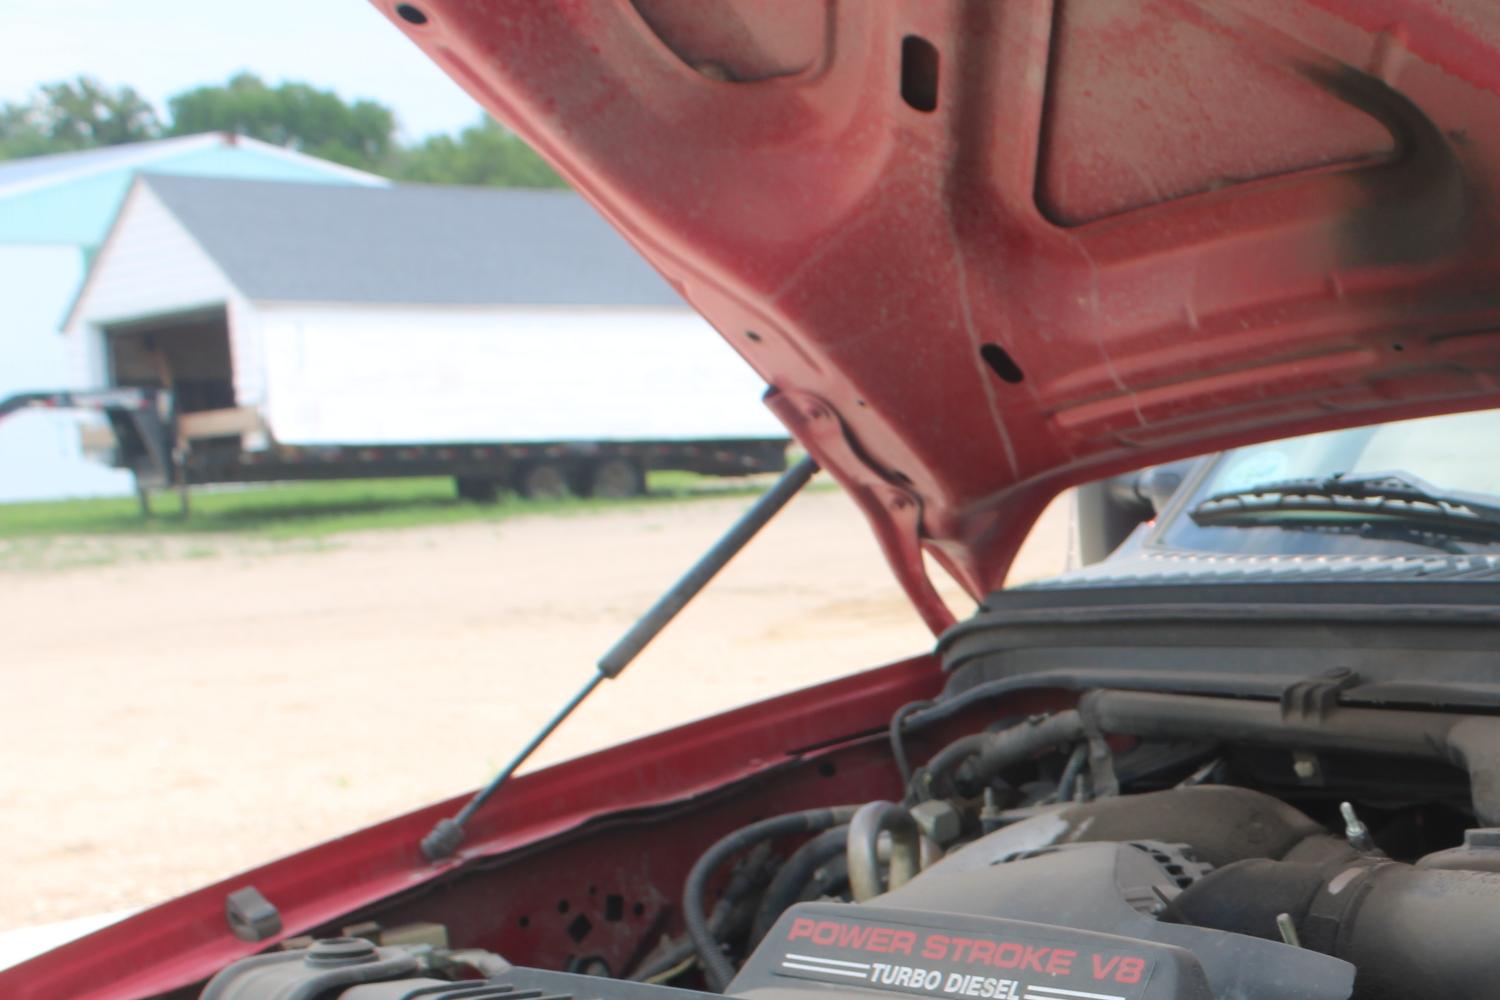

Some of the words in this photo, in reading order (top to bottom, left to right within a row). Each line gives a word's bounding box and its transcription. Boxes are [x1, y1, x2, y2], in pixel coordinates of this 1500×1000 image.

[788, 918, 914, 955] POWER
[921, 935, 1077, 974] STROKE
[1092, 955, 1146, 984] V8
[868, 962, 942, 991] TURBO
[944, 977, 1020, 1000] DIESEL
